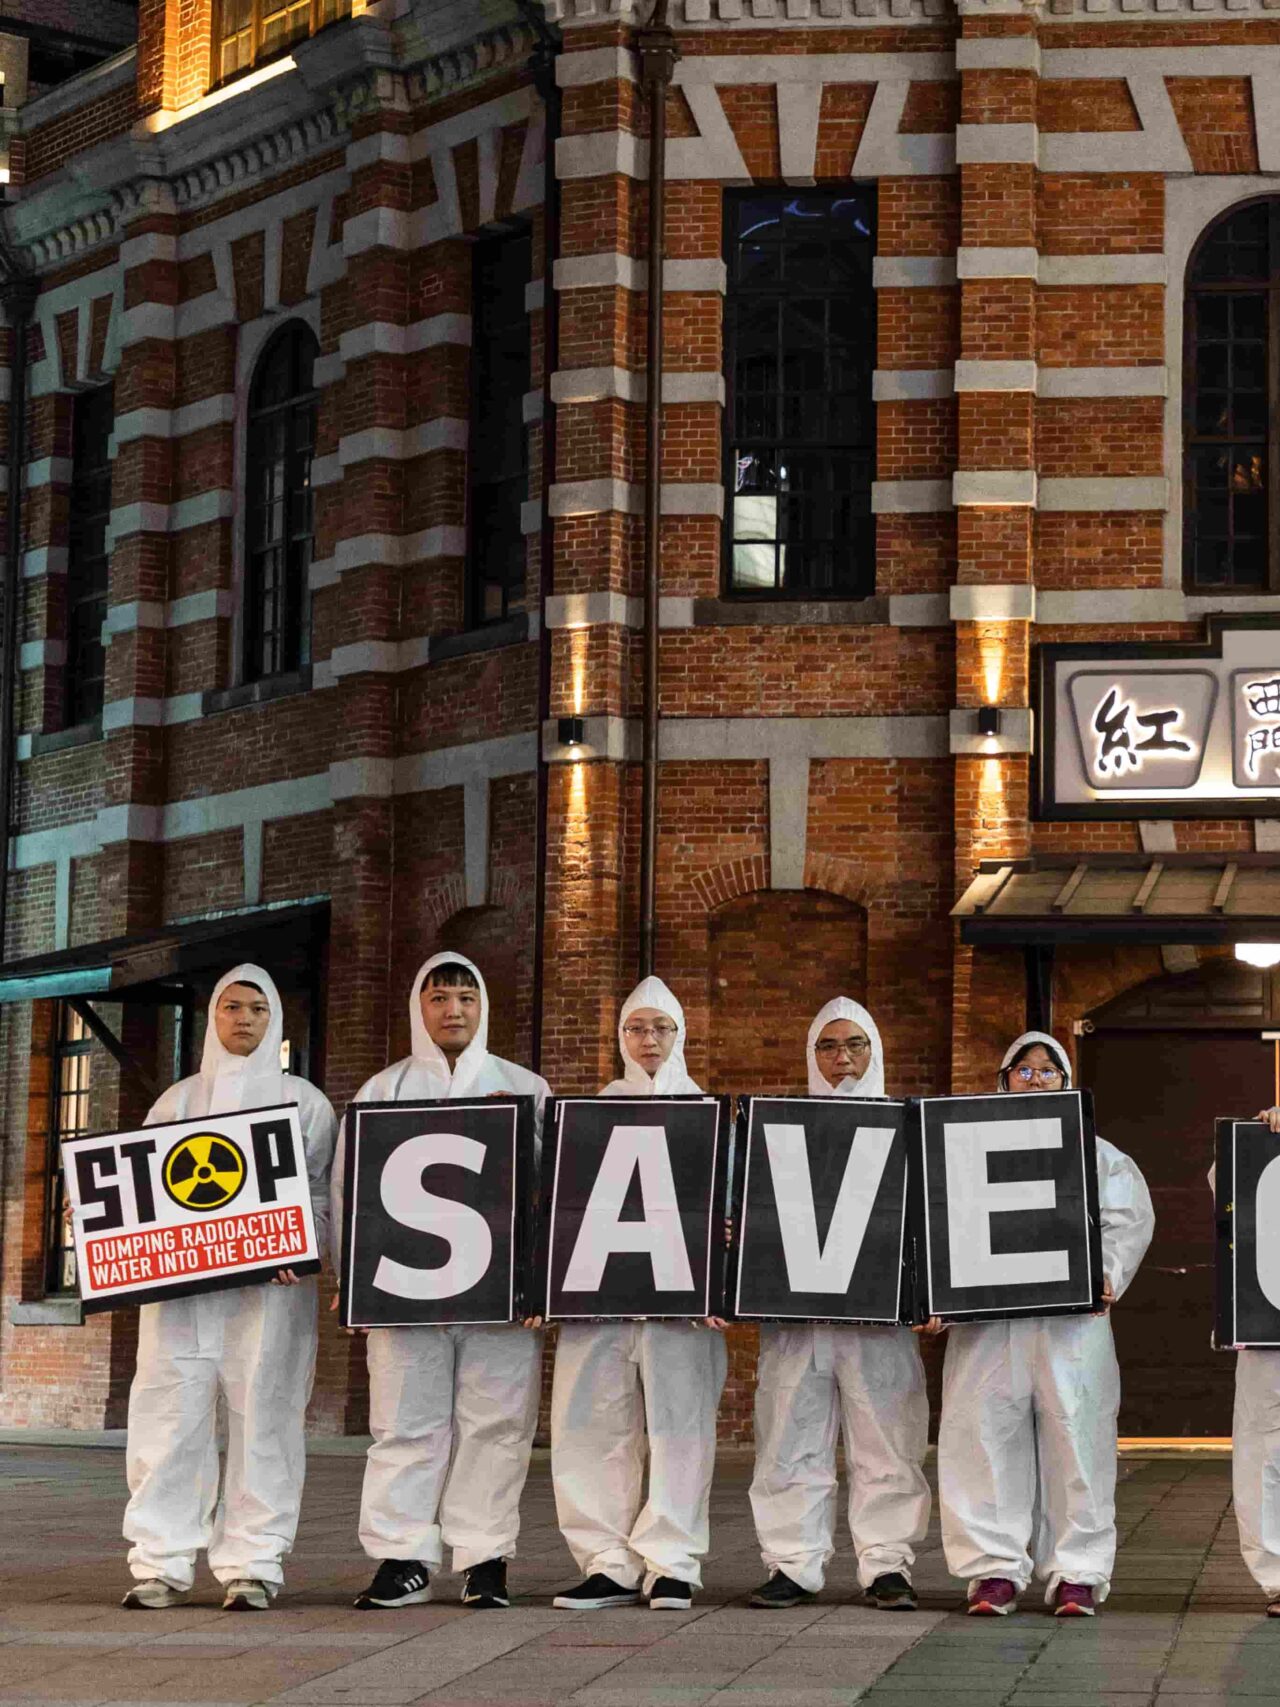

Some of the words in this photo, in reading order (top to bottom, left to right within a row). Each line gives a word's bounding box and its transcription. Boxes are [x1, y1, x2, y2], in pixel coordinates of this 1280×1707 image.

[92, 1230, 176, 1264] DUMPING
[181, 1209, 299, 1245] RADIOACTIVE
[92, 1257, 152, 1286] WATER
[158, 1249, 198, 1274] INTO
[203, 1241, 238, 1266] THE
[243, 1230, 302, 1259] OCEAN
